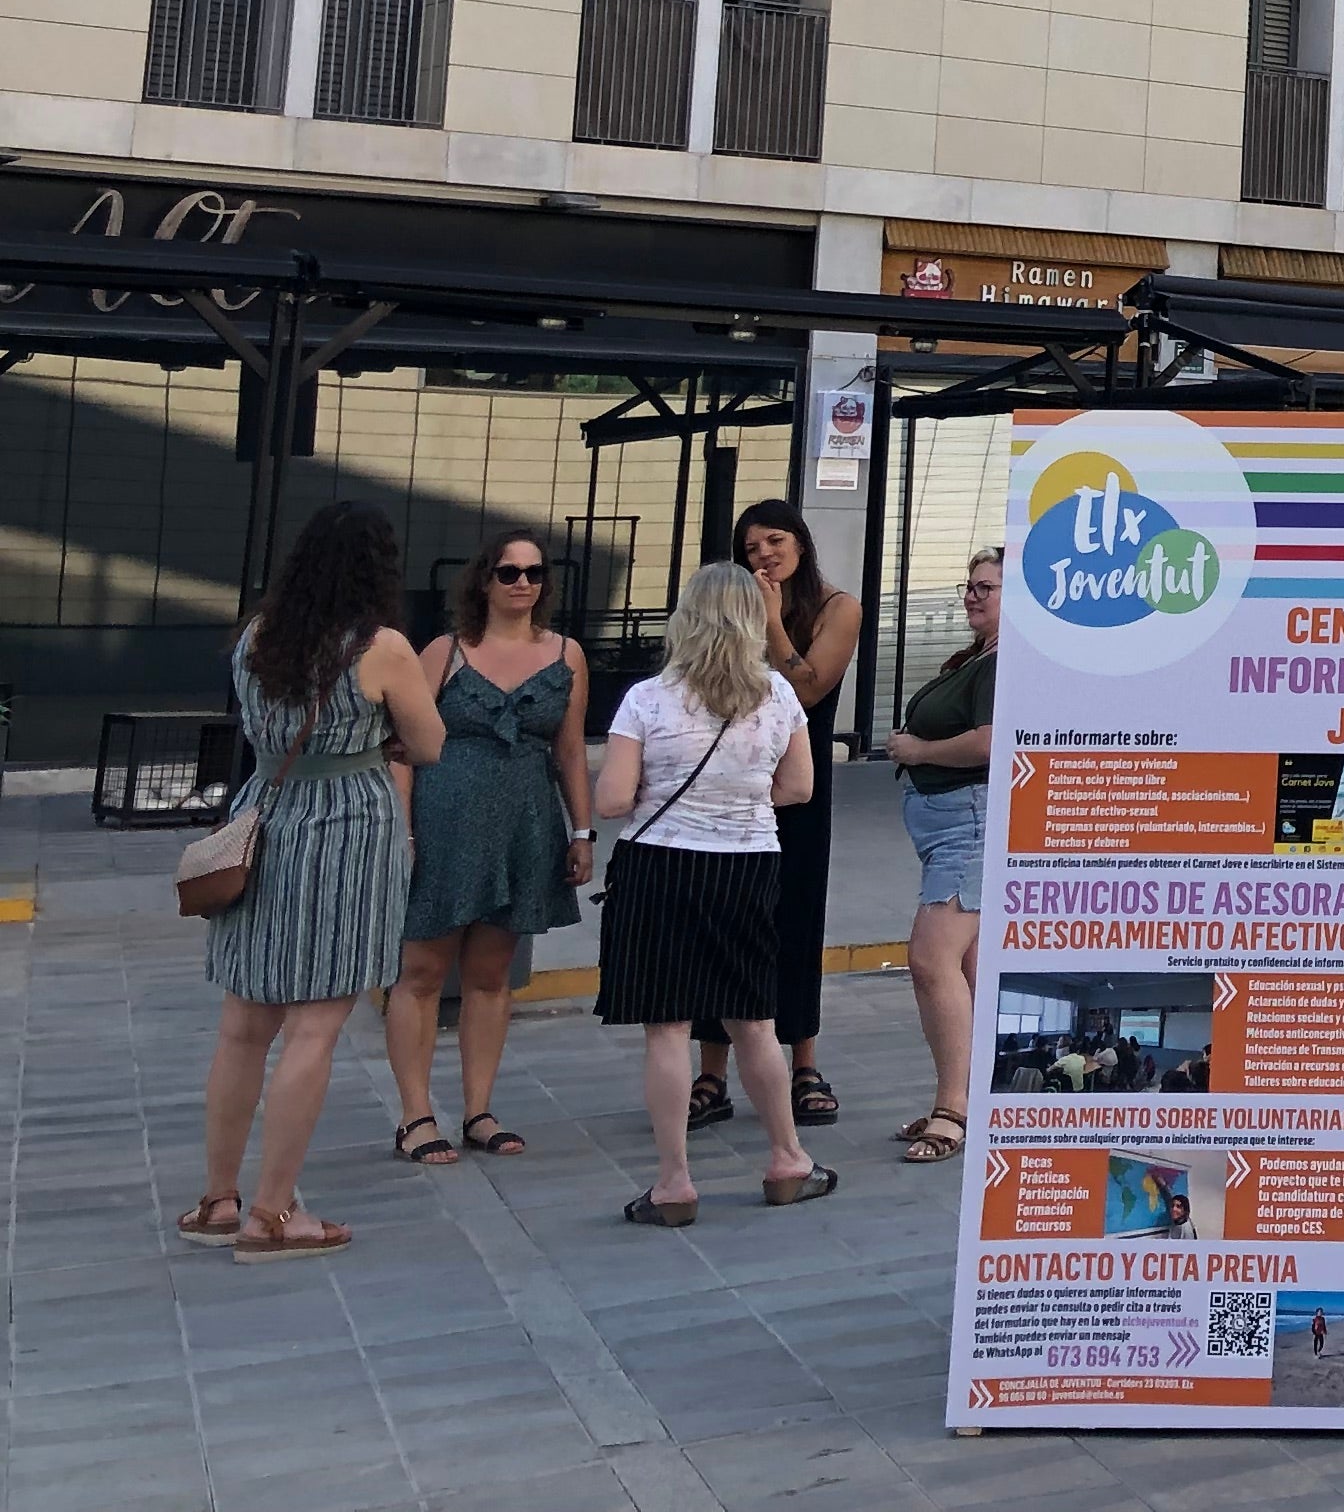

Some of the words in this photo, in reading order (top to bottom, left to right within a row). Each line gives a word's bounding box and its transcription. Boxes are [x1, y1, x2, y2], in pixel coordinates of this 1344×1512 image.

[1012, 260, 1093, 288] Ramen
[1073, 471, 1148, 555] Elx
[1046, 541, 1211, 611] Joventut
[1015, 730, 1040, 745] Ven
[1044, 733, 1050, 745] a
[1054, 730, 1131, 745] informarte
[1135, 730, 1178, 746] sobre:
[1007, 858, 1017, 867] En
[1019, 859, 1050, 868] nuestra
[1052, 858, 1080, 868] oficina
[1083, 858, 1116, 868] también
[1118, 860, 1147, 869] puedes
[1149, 859, 1181, 868] obtener
[1183, 859, 1191, 868] el
[1193, 859, 1220, 868] Carnet
[1222, 860, 1242, 869] Jove
[1250, 859, 1294, 869] inscribirte
[1308, 860, 1315, 869] el
[1004, 880, 1159, 915] SERVICIOS
[1167, 881, 1206, 914] DE
[1002, 920, 1224, 950] ASESORAMIENTO
[1168, 956, 1202, 967] Servicio
[1204, 956, 1240, 968] gratuito
[1241, 959, 1246, 969] y
[1248, 957, 1300, 968] confidencial
[1303, 958, 1313, 968] de
[1248, 980, 1294, 991] Educación
[1296, 981, 1325, 992] sexual
[1246, 1044, 1297, 1055] Infecciones
[1299, 1045, 1310, 1055] de
[989, 1107, 1151, 1129] ASESORAMIENTO
[1155, 1107, 1218, 1129] SOBRE
[989, 1134, 999, 1144] Te
[1001, 1135, 1051, 1144] asesoramos
[1053, 1134, 1077, 1144] sobre
[1079, 1134, 1120, 1146] cualquier
[1121, 1135, 1163, 1146] programa
[1165, 1136, 1170, 1144] o
[1172, 1134, 1212, 1145] iniciativa
[1214, 1137, 1248, 1146] europea
[1250, 1137, 1266, 1147] que
[1268, 1135, 1276, 1145] te
[1277, 1135, 1315, 1146] interese:
[1021, 1155, 1053, 1169] Becas
[1260, 1157, 1309, 1171] Podemos
[1020, 1172, 1070, 1184] Prácticas
[1259, 1174, 1306, 1188] proyecto
[1308, 1177, 1327, 1188] que
[1330, 1176, 1340, 1187] te
[1018, 1187, 1089, 1200] Participación
[1259, 1190, 1269, 1201] tu
[1271, 1190, 1335, 1202] candidatura
[1017, 1203, 1073, 1216] Formación
[1257, 1205, 1274, 1218] del
[1276, 1208, 1328, 1220] programa
[1330, 1206, 1343, 1219] de
[1016, 1219, 1072, 1232] Concursos
[1257, 1223, 1300, 1236] europeo
[1302, 1222, 1325, 1235] CES.
[978, 1252, 1114, 1283] CONTACTO
[1121, 1253, 1137, 1281] Y
[1142, 1253, 1199, 1281] CITA
[1207, 1254, 1299, 1284] PREVIA
[1048, 1345, 1081, 1368] 673
[1086, 1346, 1121, 1368] 694
[1126, 1345, 1159, 1368] 753
